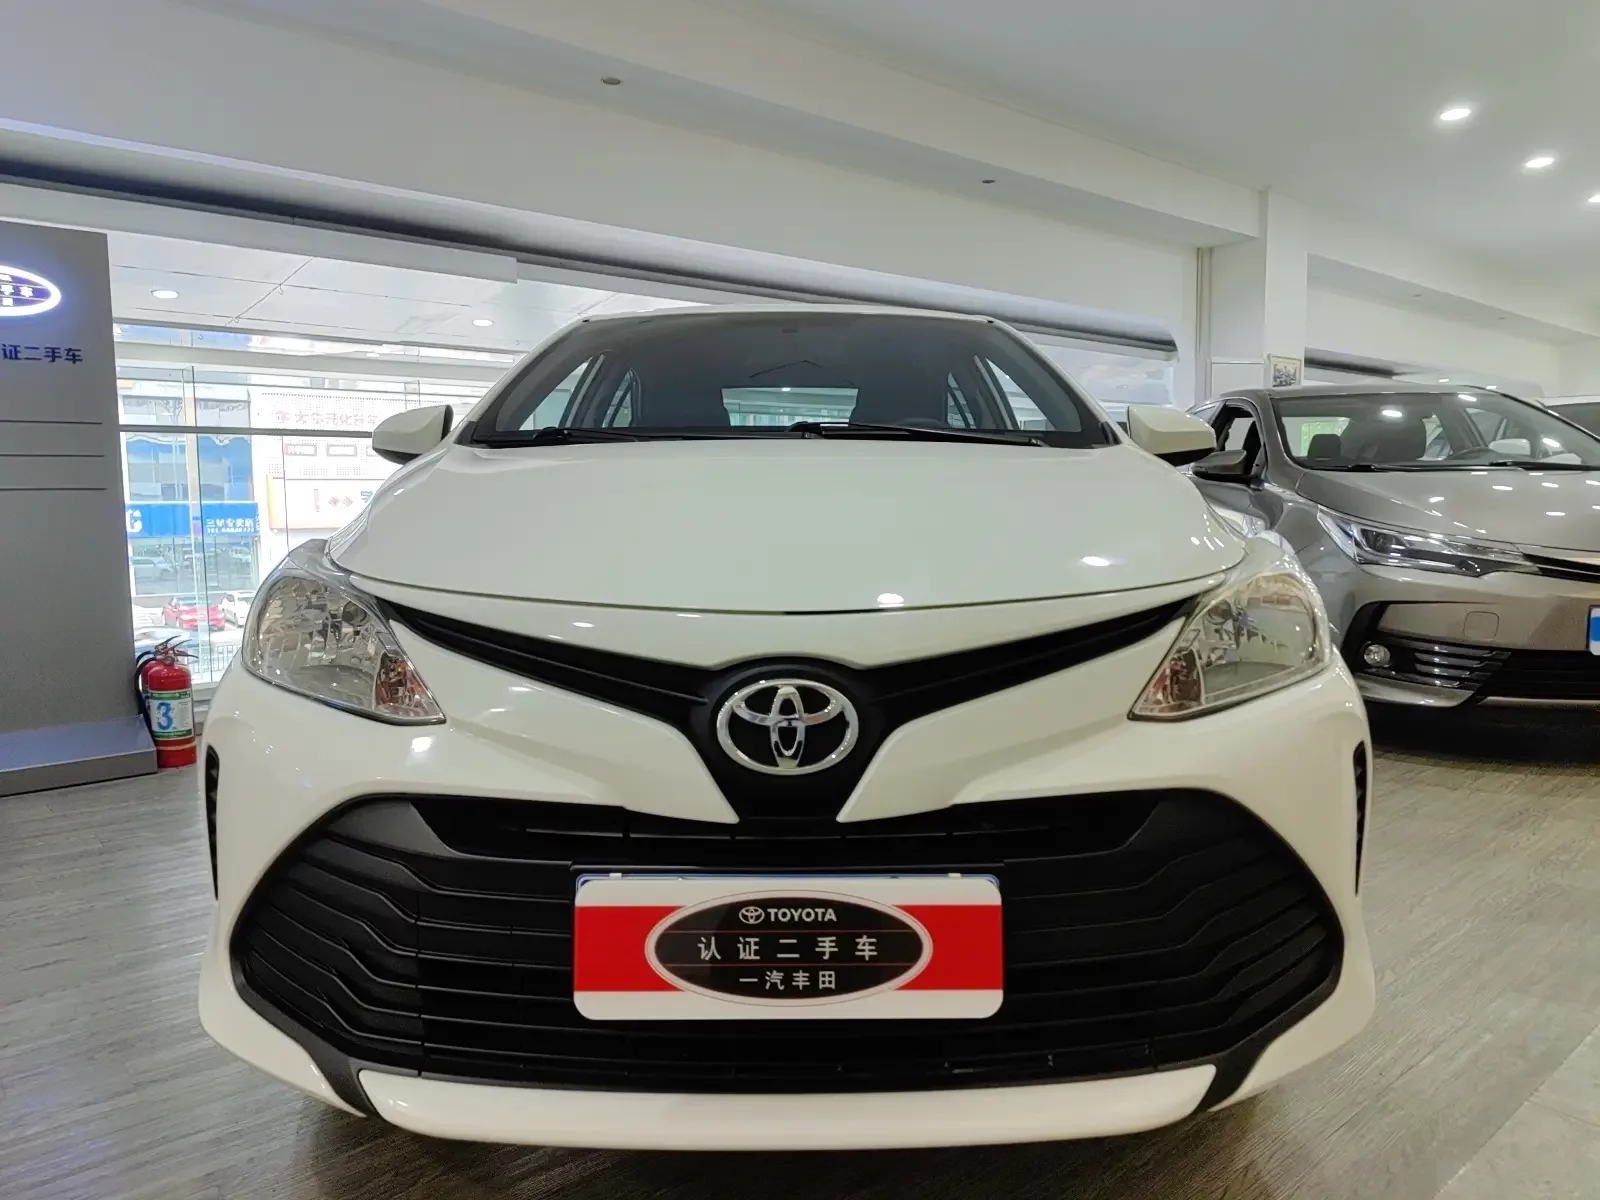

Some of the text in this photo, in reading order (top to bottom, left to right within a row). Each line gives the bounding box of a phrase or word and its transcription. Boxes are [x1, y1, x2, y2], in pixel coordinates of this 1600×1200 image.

[0, 344, 83, 365] 证二手车
[157, 702, 173, 730] 3
[767, 908, 838, 922] TOYOTA
[697, 935, 878, 961] 认证二手车
[739, 970, 836, 990] 一汽丰田
